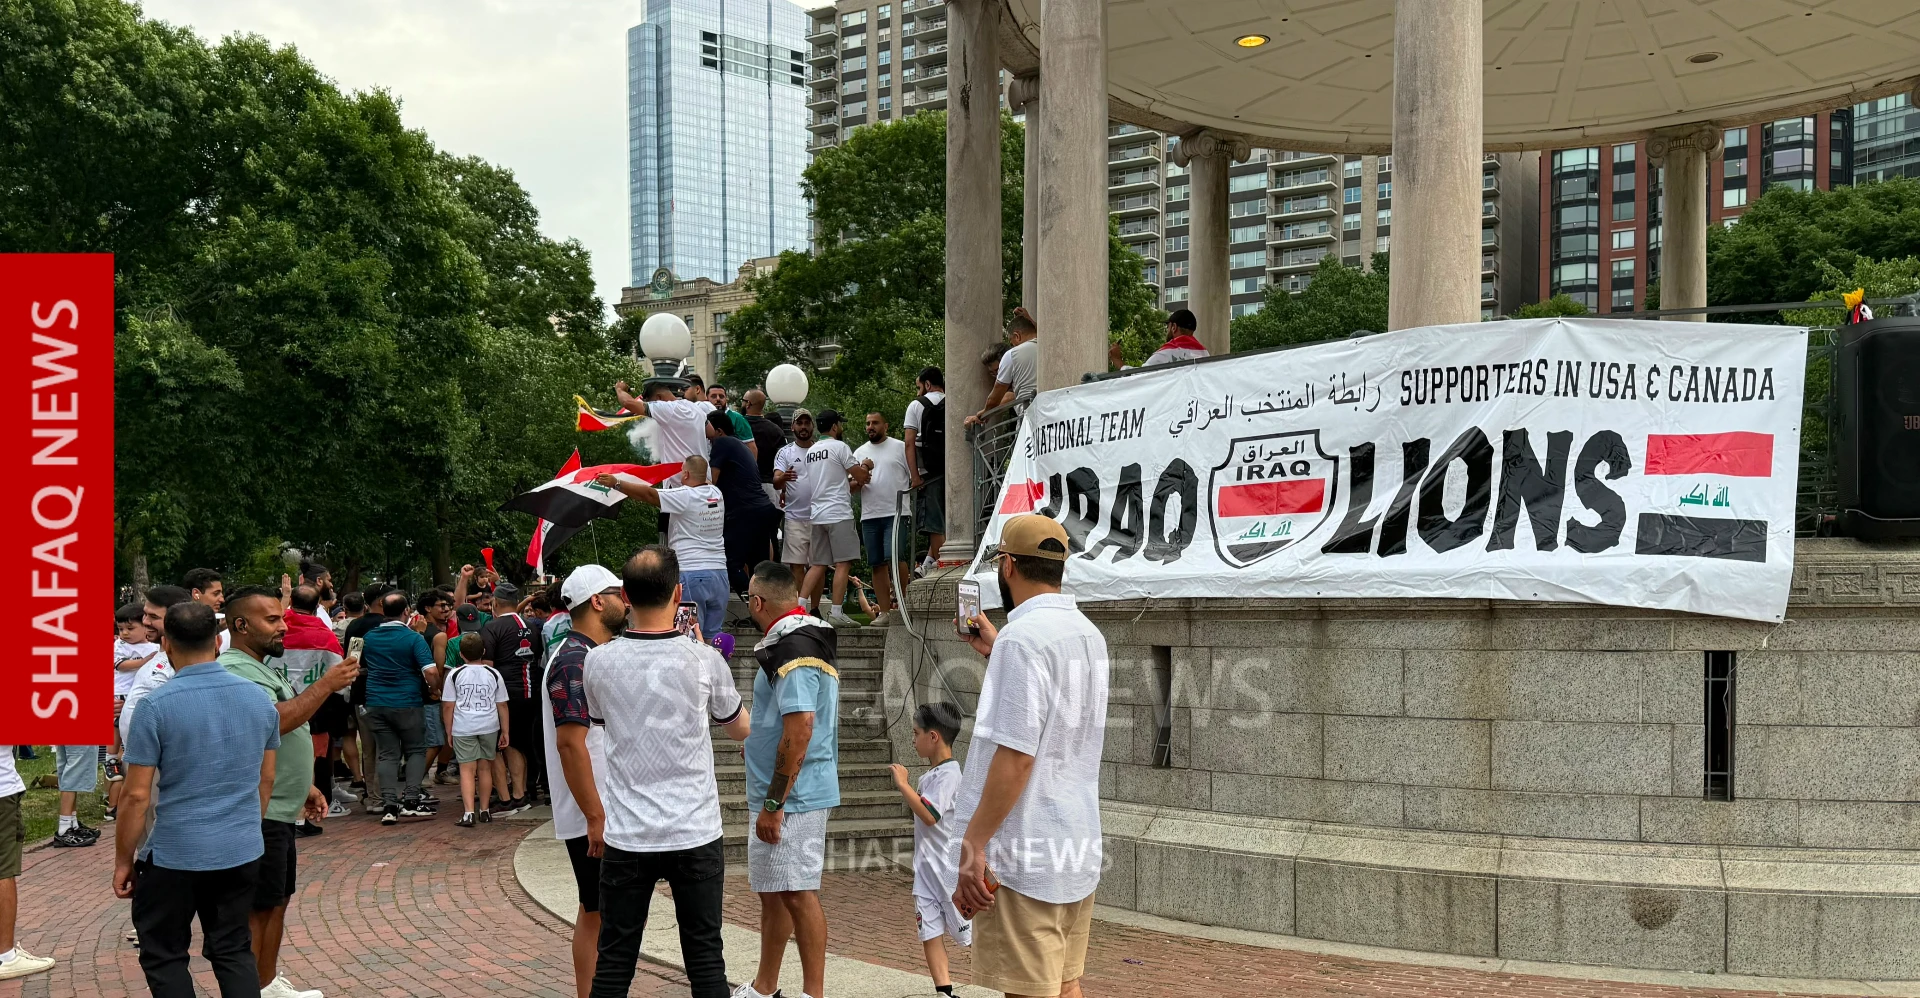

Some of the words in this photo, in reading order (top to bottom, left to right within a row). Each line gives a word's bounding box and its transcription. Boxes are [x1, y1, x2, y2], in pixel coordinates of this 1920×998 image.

[1327, 371, 1381, 412] رابطة
[1400, 358, 1547, 406] SUPPORTERS
[1554, 359, 1581, 398] IN
[1589, 361, 1637, 400] USA
[1646, 362, 1661, 400] &
[1669, 366, 1775, 403] CANADA
[1168, 394, 1234, 438] العراقي
[1240, 382, 1315, 422] المنتخب
[1034, 416, 1094, 456] NATIONAL
[1100, 407, 1146, 442] TEAM
[806, 449, 829, 463] IRAQ
[1242, 439, 1305, 463] العراق
[1236, 460, 1311, 481] IRAQ
[1320, 425, 1633, 557] LIONS
[1678, 483, 1709, 507] اكبر
[1712, 483, 1730, 507] الله
[458, 683, 493, 712] 73
